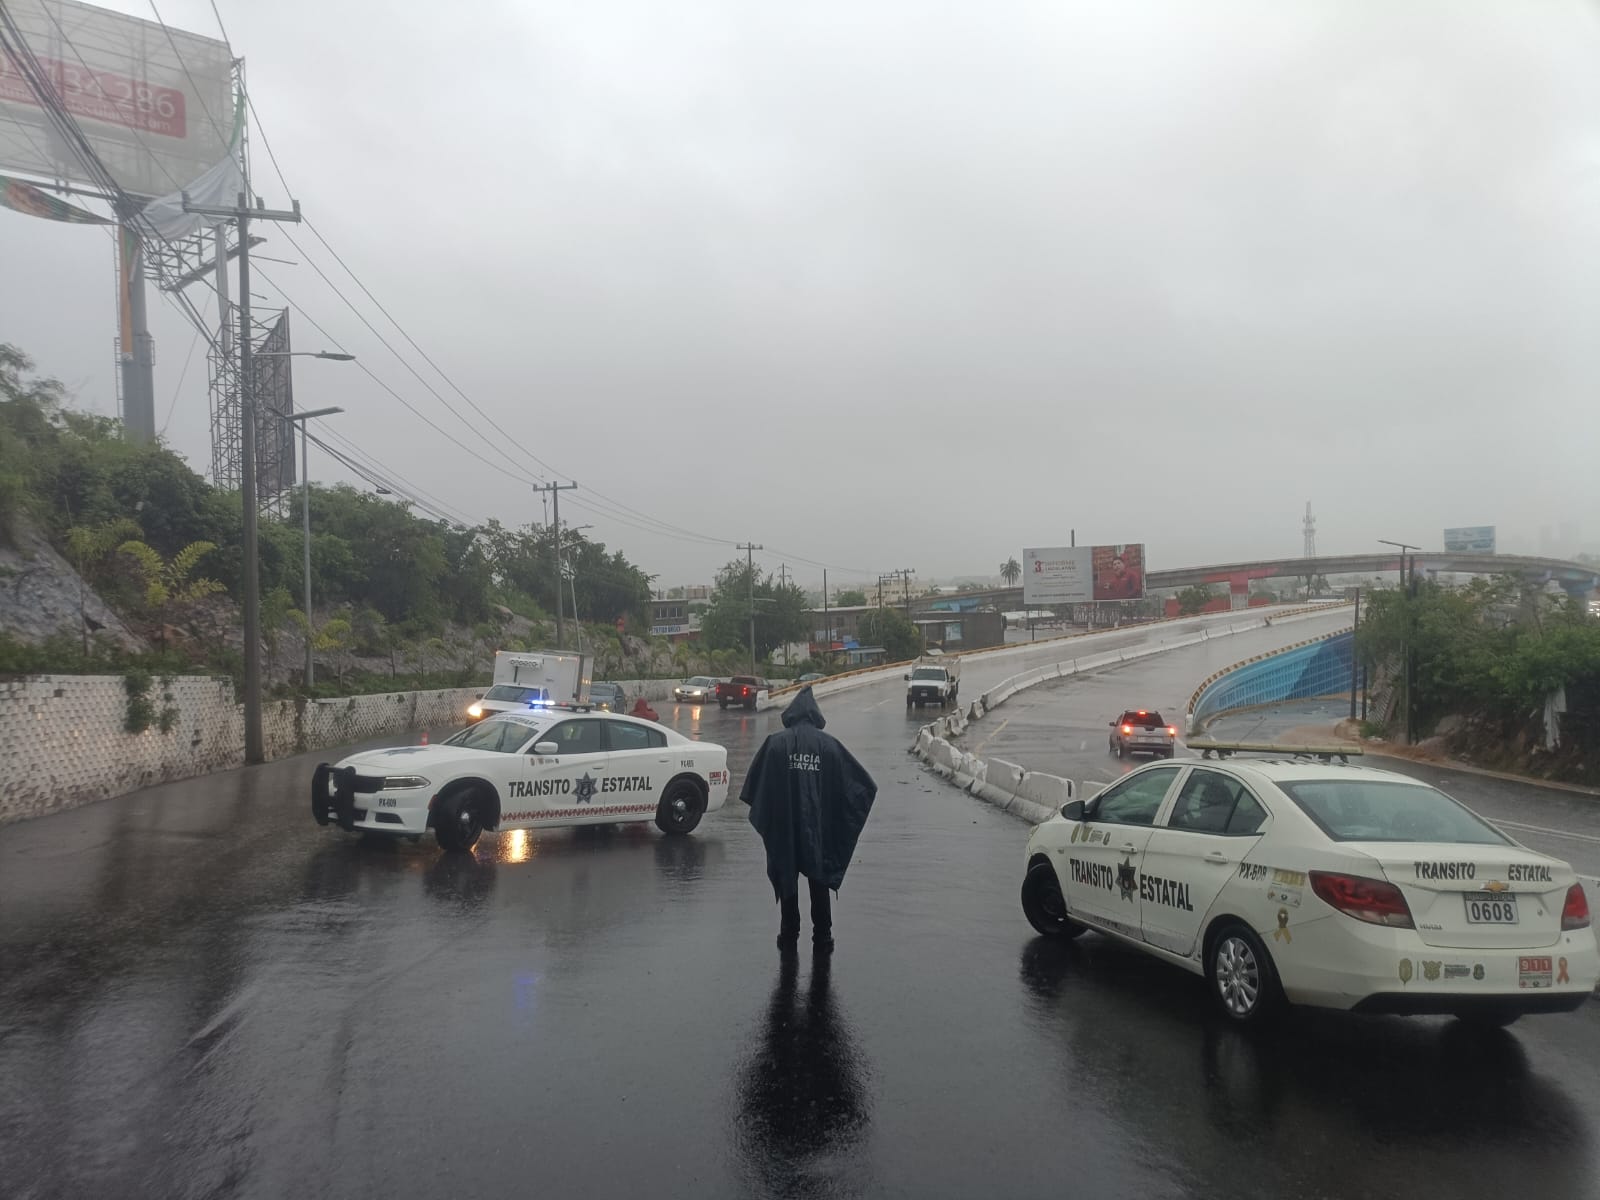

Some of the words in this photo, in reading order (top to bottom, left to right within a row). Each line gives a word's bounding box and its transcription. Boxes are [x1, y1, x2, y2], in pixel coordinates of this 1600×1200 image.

[115, 80, 176, 118] 286
[508, 779, 570, 798] TRANSITO
[601, 776, 653, 793] ESTATAL
[1413, 861, 1476, 880] TRANSITO
[1507, 864, 1553, 882] ESTATAL
[1069, 858, 1114, 891] TRANSITO
[1140, 873, 1194, 912] ESTATAL
[1471, 902, 1514, 921] 0608
[1520, 959, 1550, 970] 911
